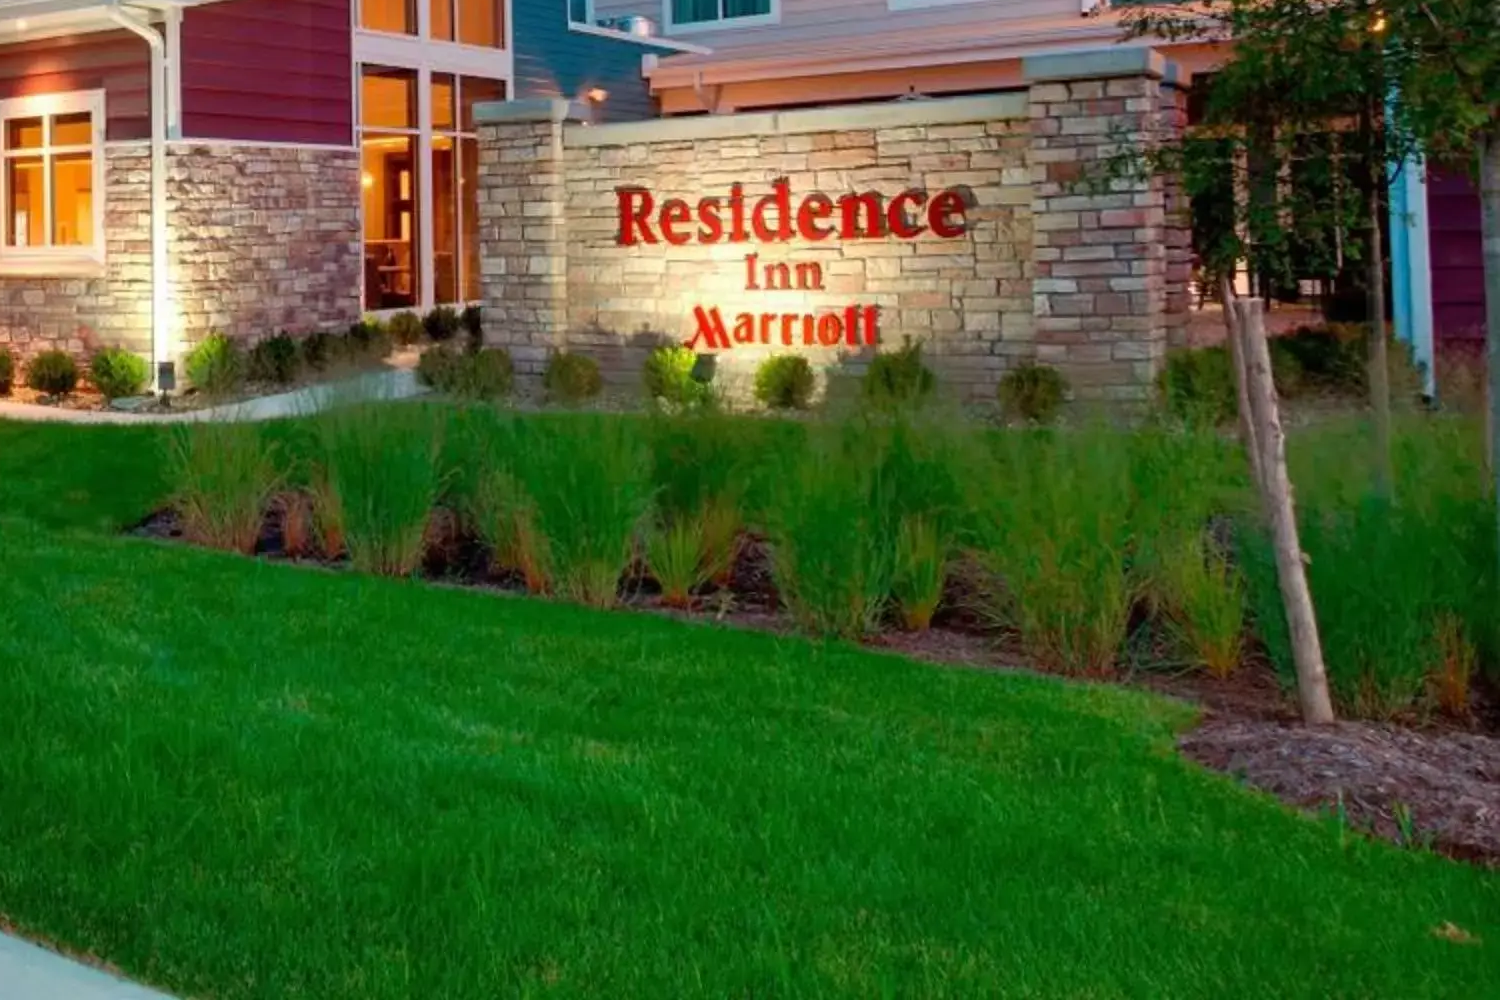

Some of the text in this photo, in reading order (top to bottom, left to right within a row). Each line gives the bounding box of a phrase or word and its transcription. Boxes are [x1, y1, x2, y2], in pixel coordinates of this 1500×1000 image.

[616, 177, 967, 246] Residence
[745, 253, 825, 290] Inn
[683, 304, 881, 349] Marriott
